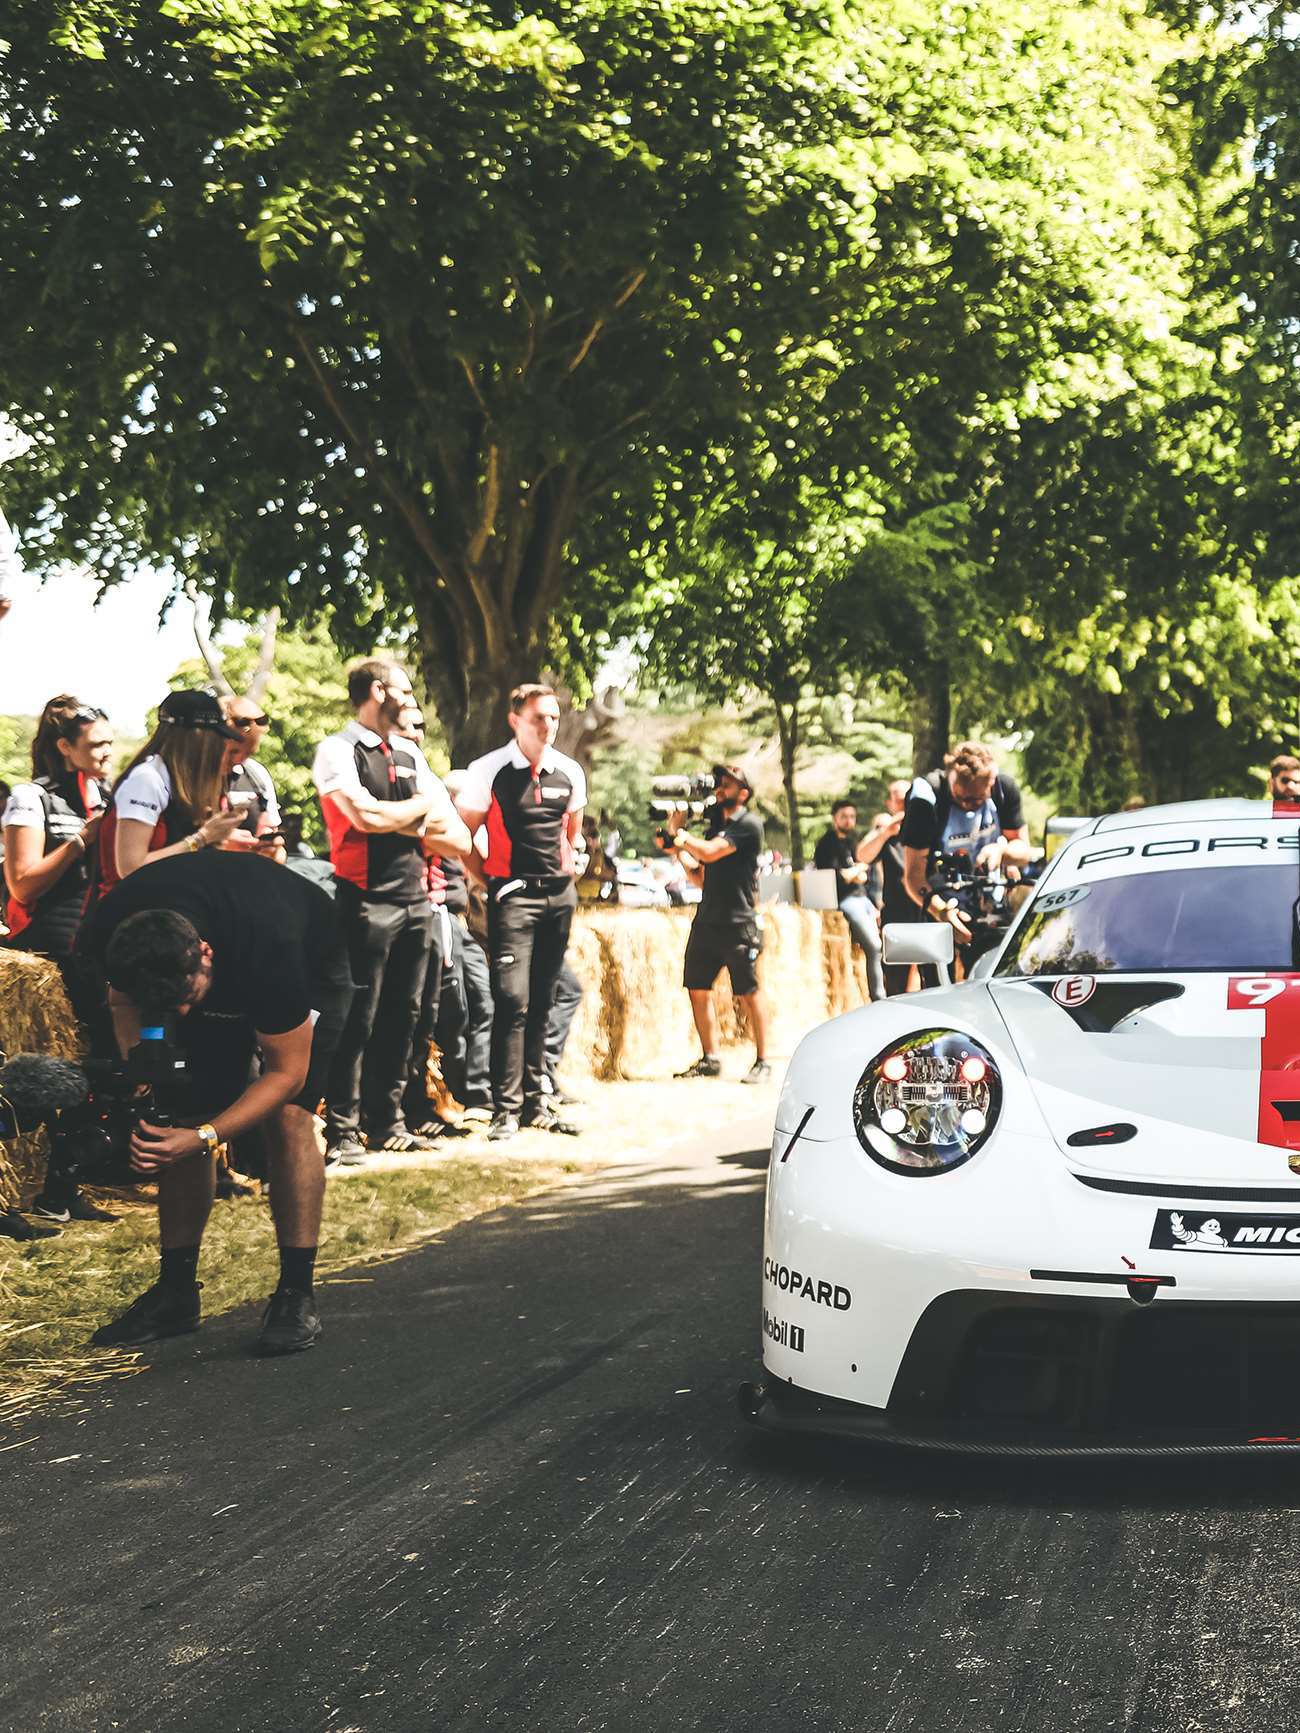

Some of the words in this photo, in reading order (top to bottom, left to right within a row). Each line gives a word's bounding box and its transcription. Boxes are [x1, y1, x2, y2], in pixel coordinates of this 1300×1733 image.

[1043, 889, 1080, 909] 567
[1066, 979, 1083, 1001] E
[765, 1256, 852, 1311] CHOPARD
